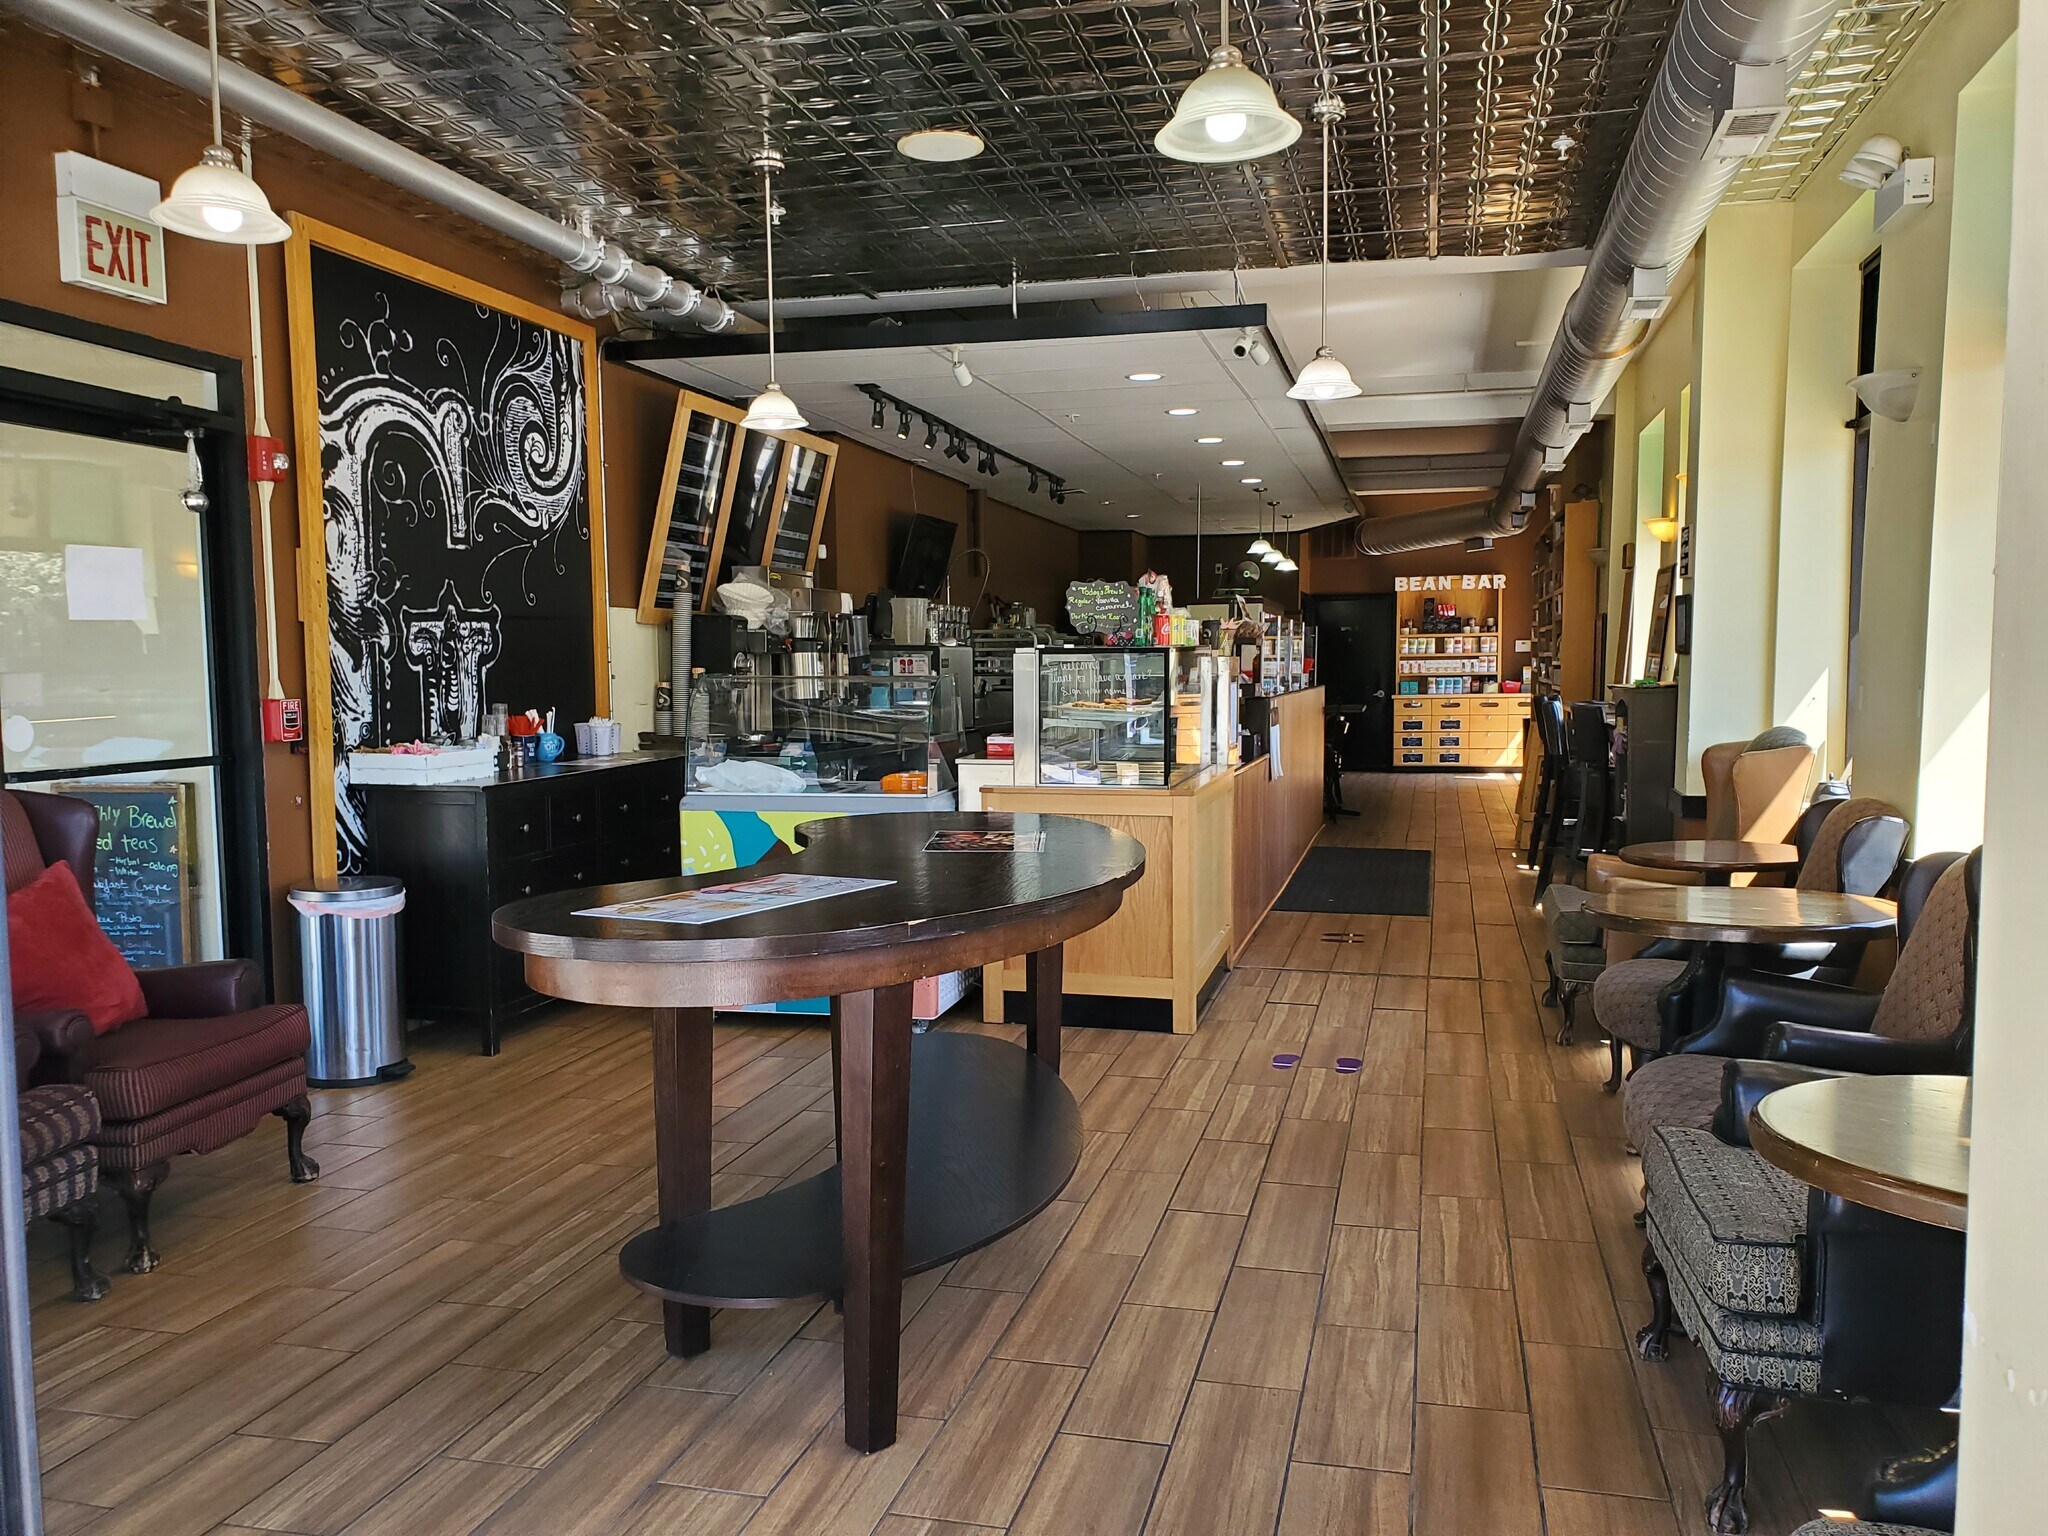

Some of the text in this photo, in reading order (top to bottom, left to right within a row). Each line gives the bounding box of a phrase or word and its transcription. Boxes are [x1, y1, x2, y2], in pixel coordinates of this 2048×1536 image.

[85, 215, 152, 288] EXIT
[1395, 574, 1507, 592] BEAN BAR
[282, 701, 299, 710] FIRE
[120, 833, 158, 853] teas
